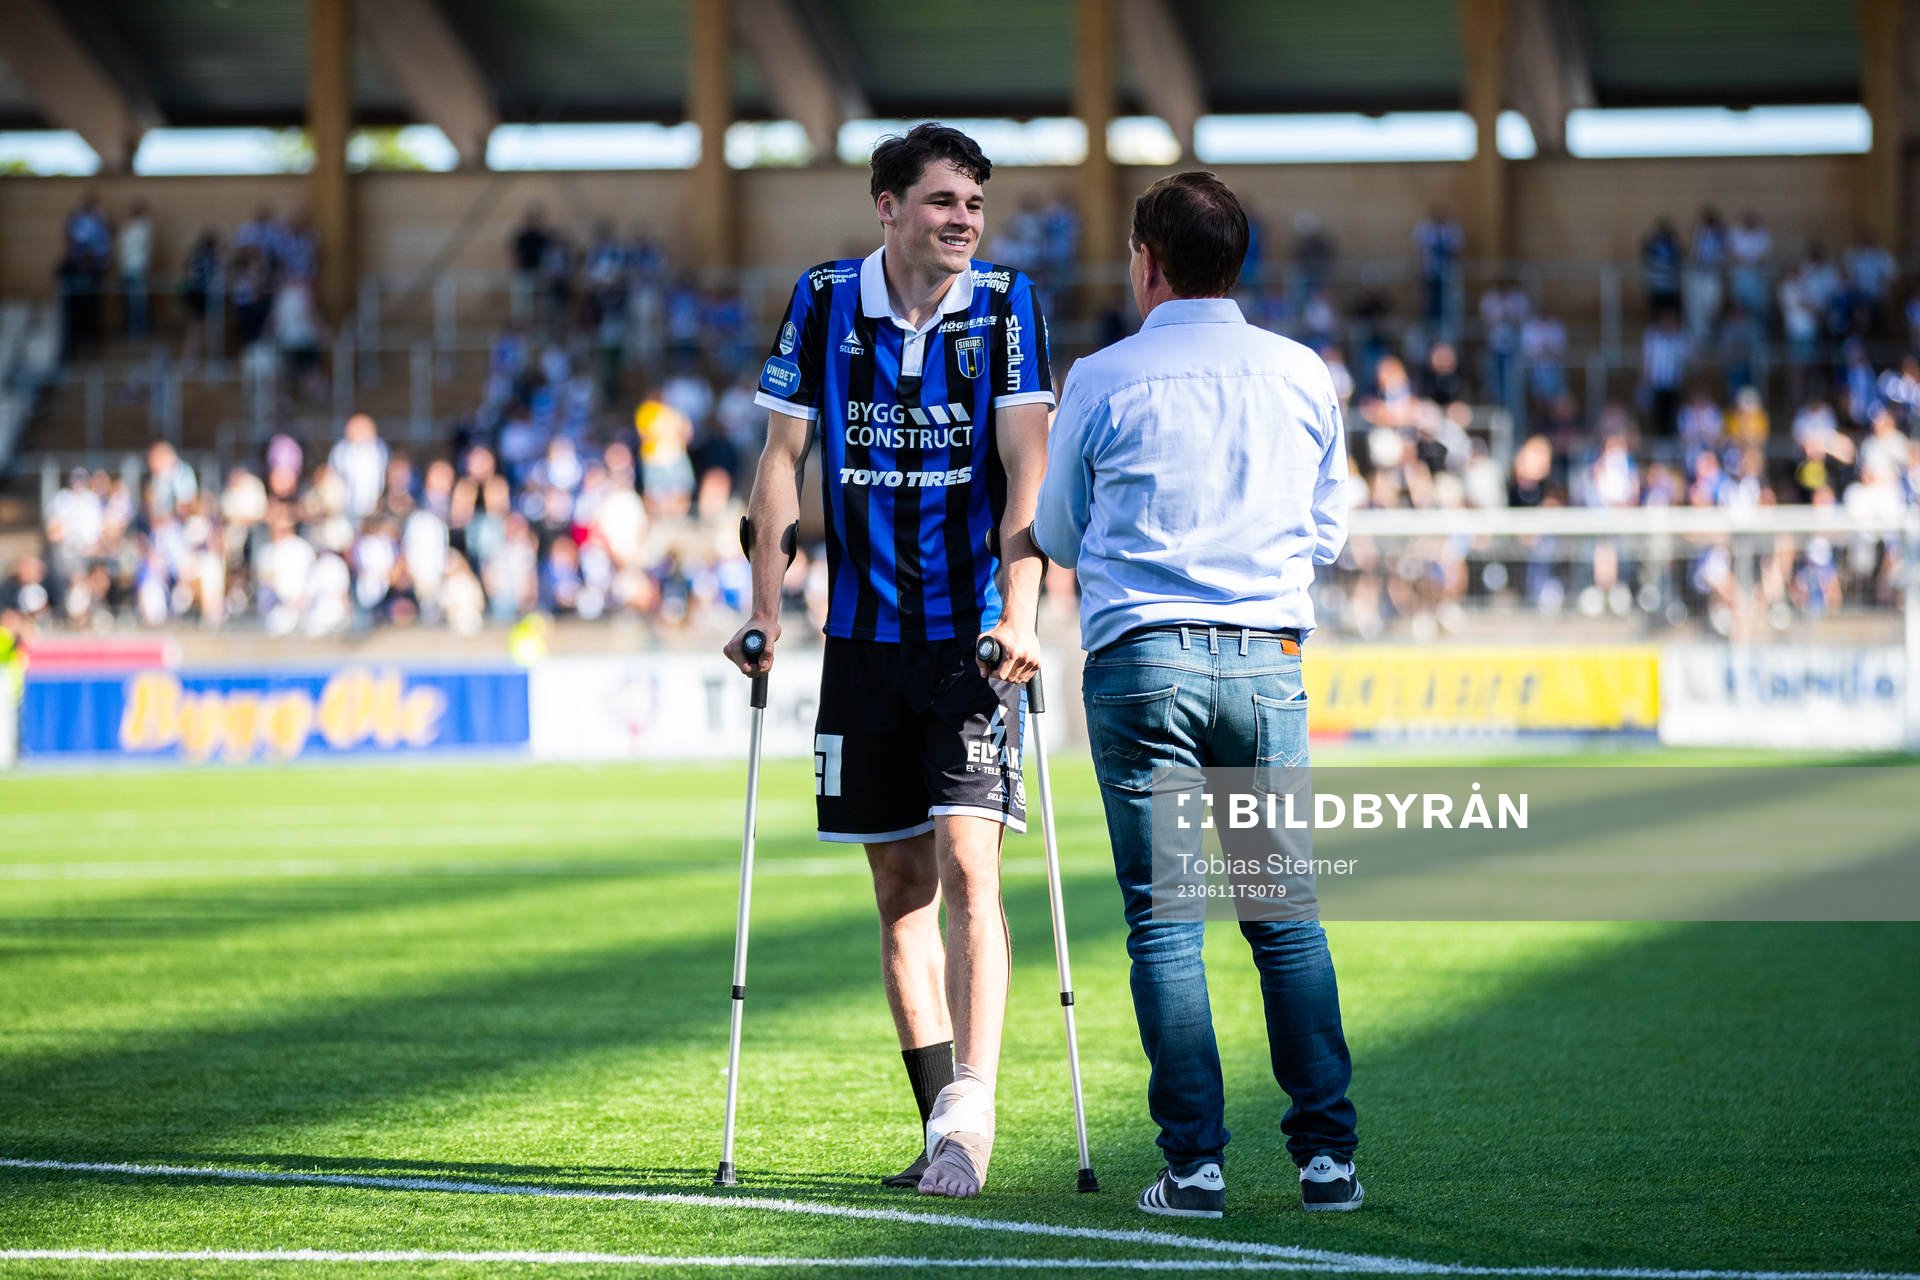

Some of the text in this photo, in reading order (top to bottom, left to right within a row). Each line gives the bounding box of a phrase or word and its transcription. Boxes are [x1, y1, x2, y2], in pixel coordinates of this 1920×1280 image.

[839, 344, 865, 355] SELECT
[958, 339, 982, 349] SIRIUS
[1005, 315, 1024, 391] stadium
[766, 364, 797, 383] UNIBET
[847, 400, 905, 424] BYGG
[845, 425, 973, 449] CONSTRUCT
[839, 466, 972, 488] TOYO TIRES
[987, 793, 1008, 802] SELECT
